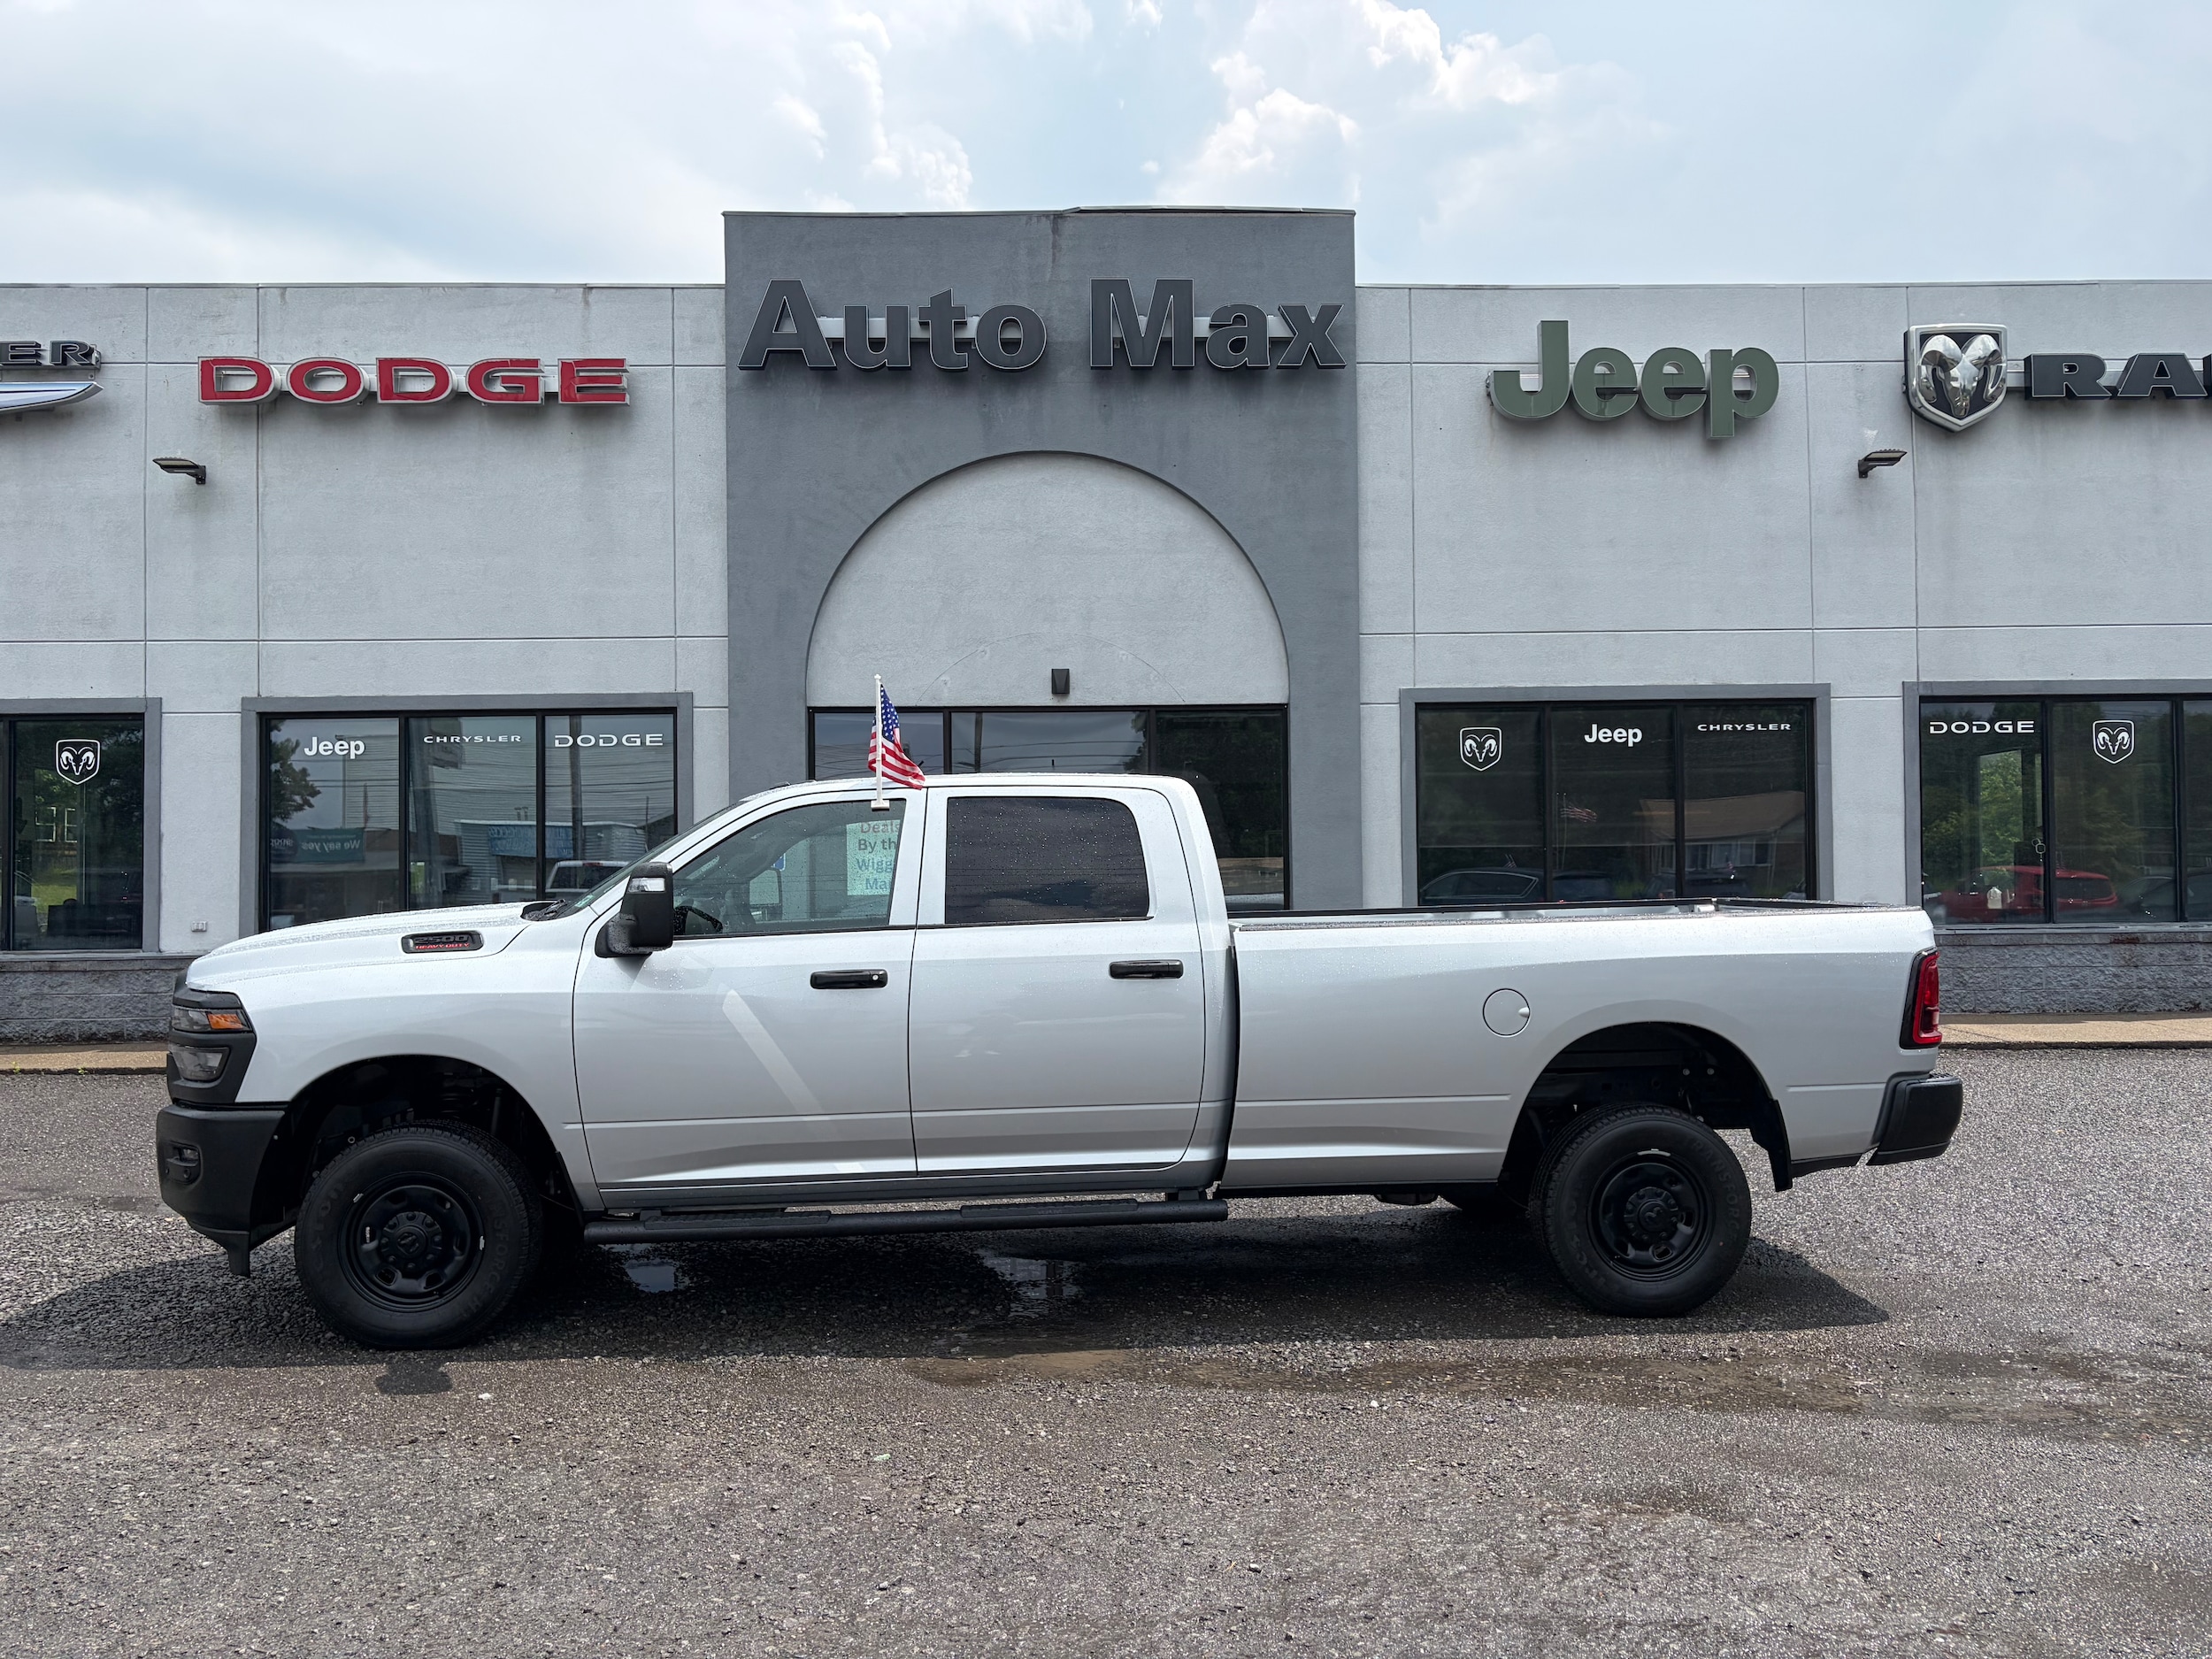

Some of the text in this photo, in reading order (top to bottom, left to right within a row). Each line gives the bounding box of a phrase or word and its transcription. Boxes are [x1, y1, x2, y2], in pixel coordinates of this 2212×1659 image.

[737, 277, 1347, 372] Auto Max
[198, 356, 631, 406] DODGE
[1490, 319, 1780, 439] Jeep
[2024, 352, 2212, 399] RA
[1584, 723, 1643, 747] Jeep
[1697, 723, 1792, 732] CHRYSLER
[1929, 720, 2035, 734] DODGE
[303, 736, 365, 759] Jeep
[423, 734, 522, 744] CHRYSLER
[554, 733, 664, 748] DODGE
[857, 837, 897, 854] By th
[856, 856, 893, 873] Wigg
[865, 877, 890, 890] Ma
[413, 934, 468, 944] 2500
